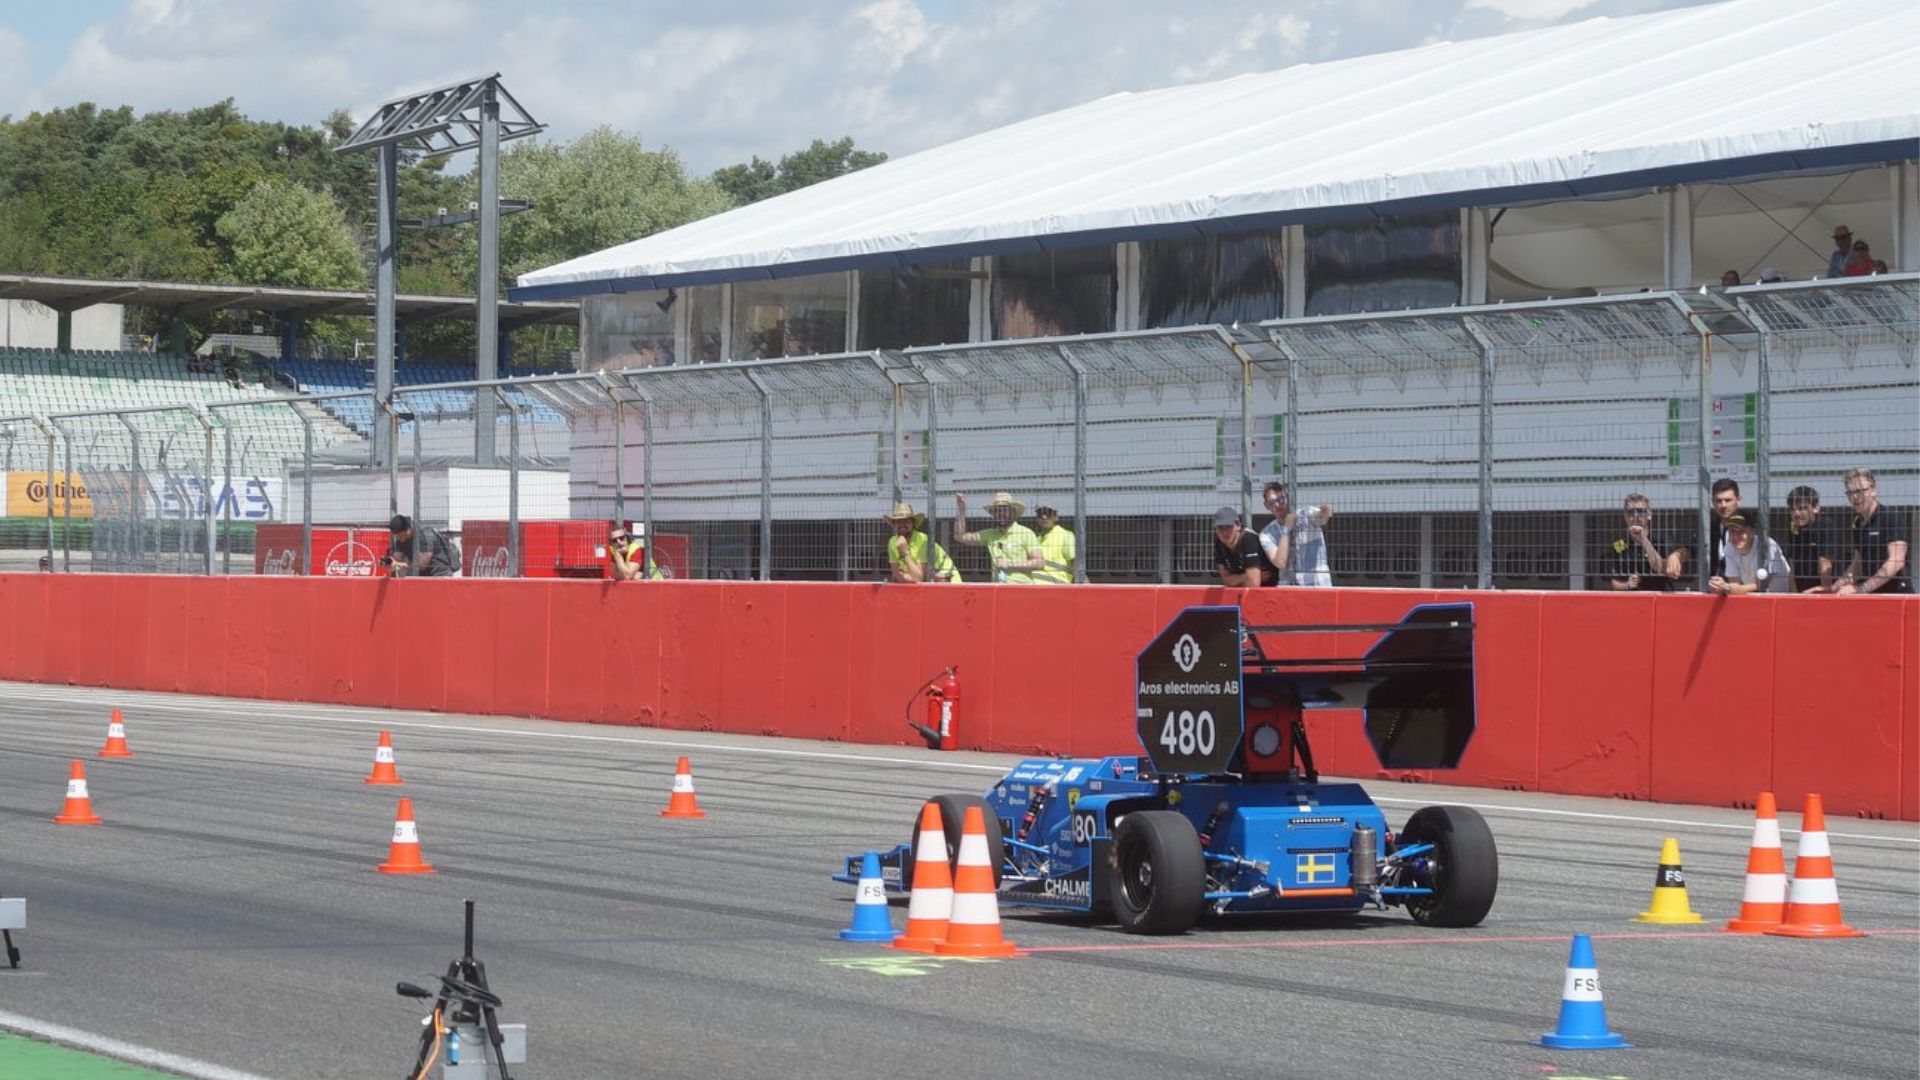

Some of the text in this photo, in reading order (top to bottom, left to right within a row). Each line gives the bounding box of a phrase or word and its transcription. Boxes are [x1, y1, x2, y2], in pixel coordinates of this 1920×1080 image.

[1139, 681, 1239, 695] Aros electronics AB
[1160, 710, 1216, 756] 480
[1073, 815, 1096, 843] 80
